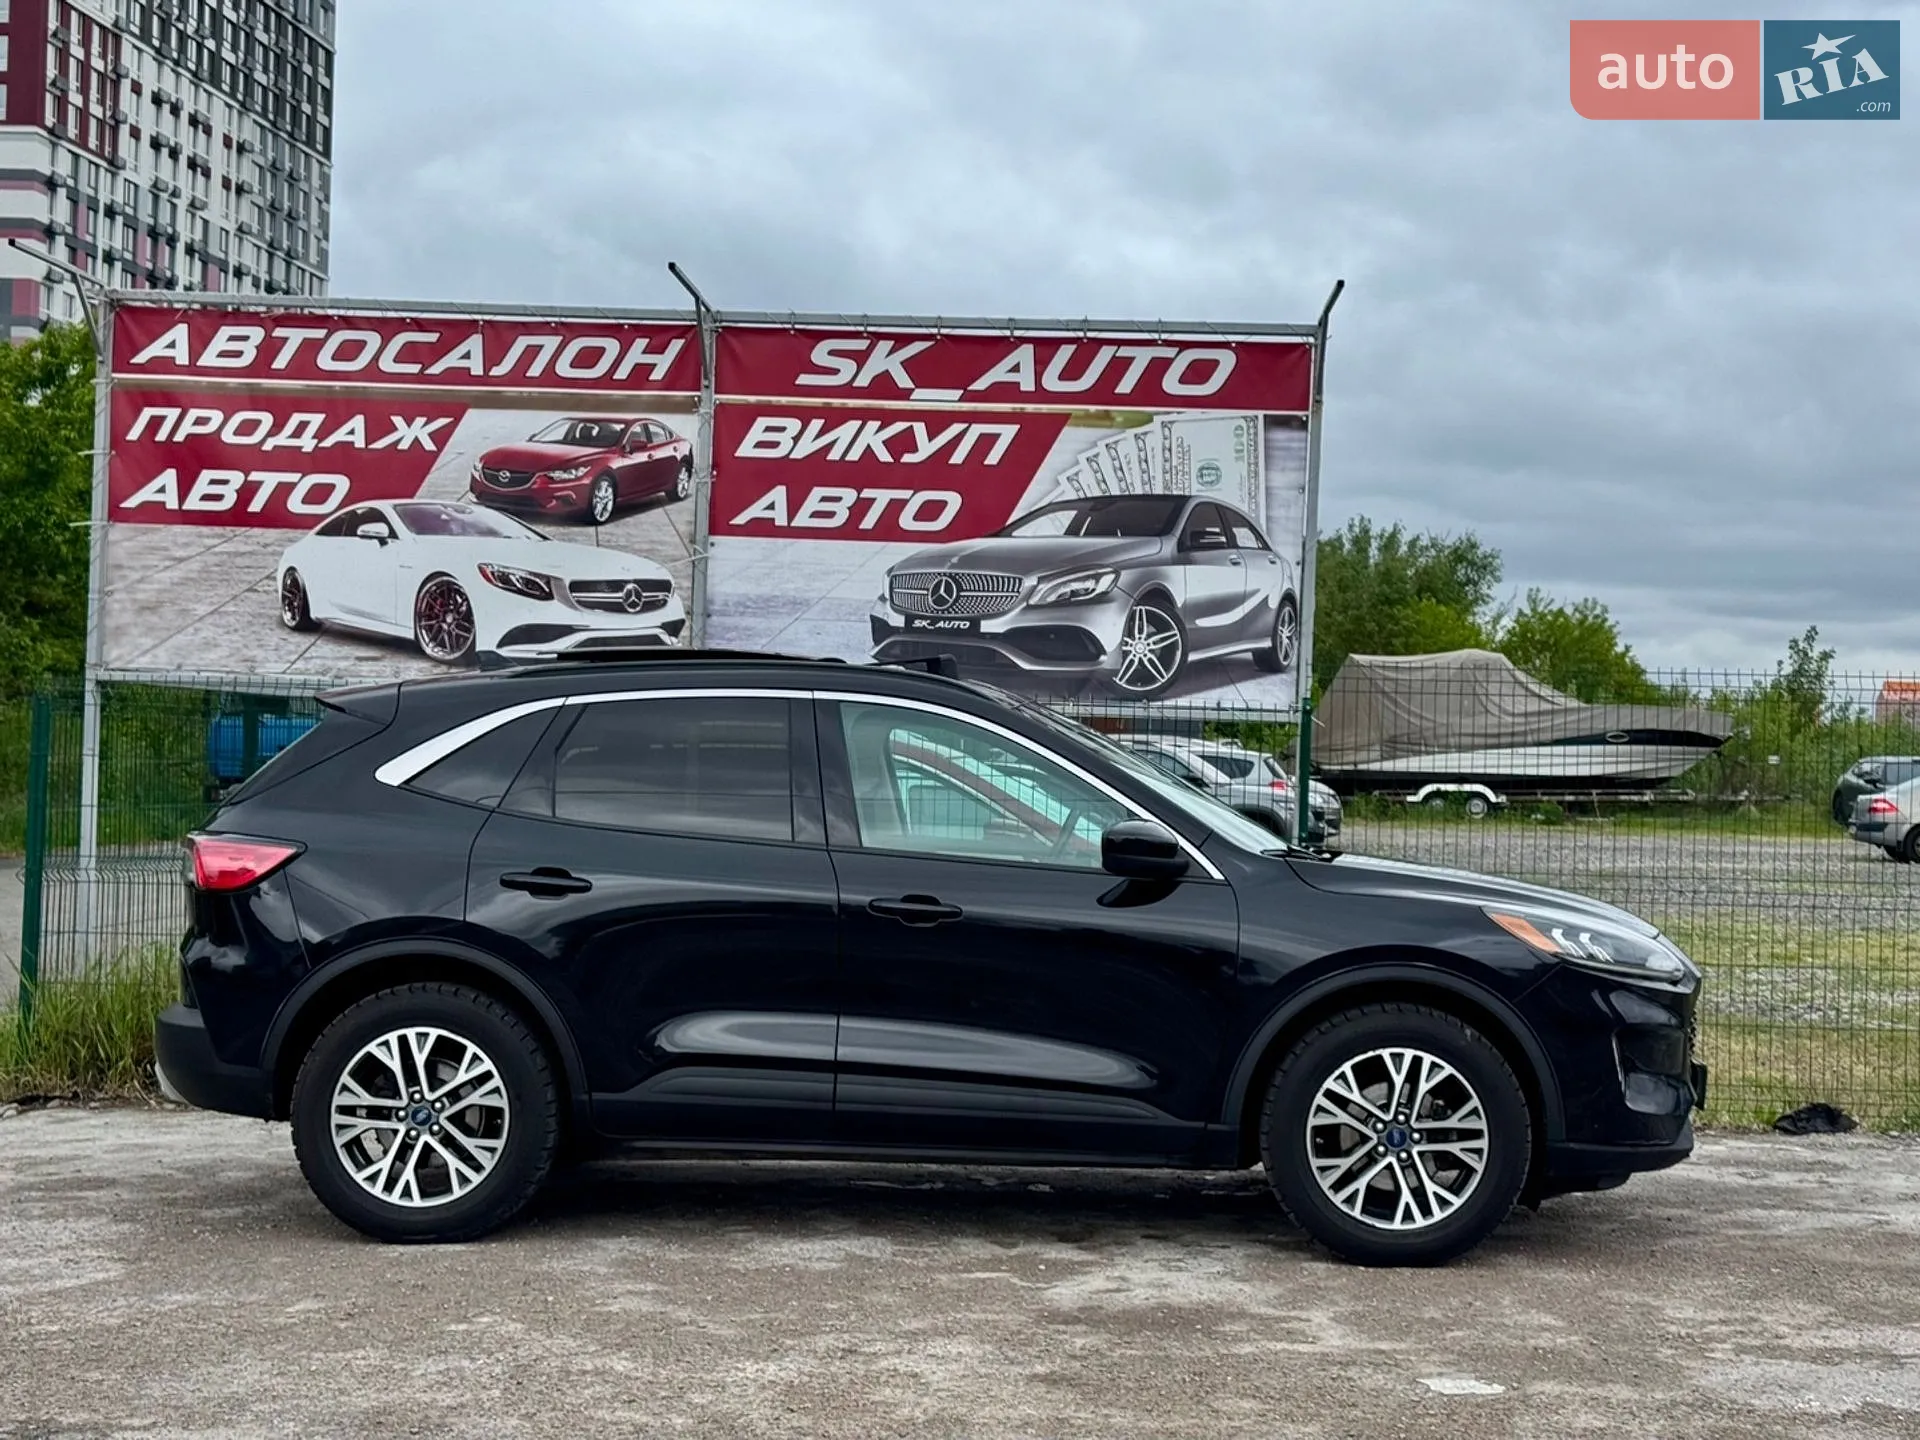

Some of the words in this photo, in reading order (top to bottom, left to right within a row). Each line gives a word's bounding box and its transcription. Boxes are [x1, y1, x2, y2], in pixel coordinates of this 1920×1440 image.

[129, 322, 686, 381] АВТОСАЛОН
[794, 338, 1237, 402] SK_AUTO
[125, 406, 455, 453] ПРОДАЖ
[734, 416, 1021, 465] ВИКУП
[119, 468, 351, 515] АВТО
[728, 484, 963, 532] АВТО
[911, 619, 971, 630] SK_AUTO
